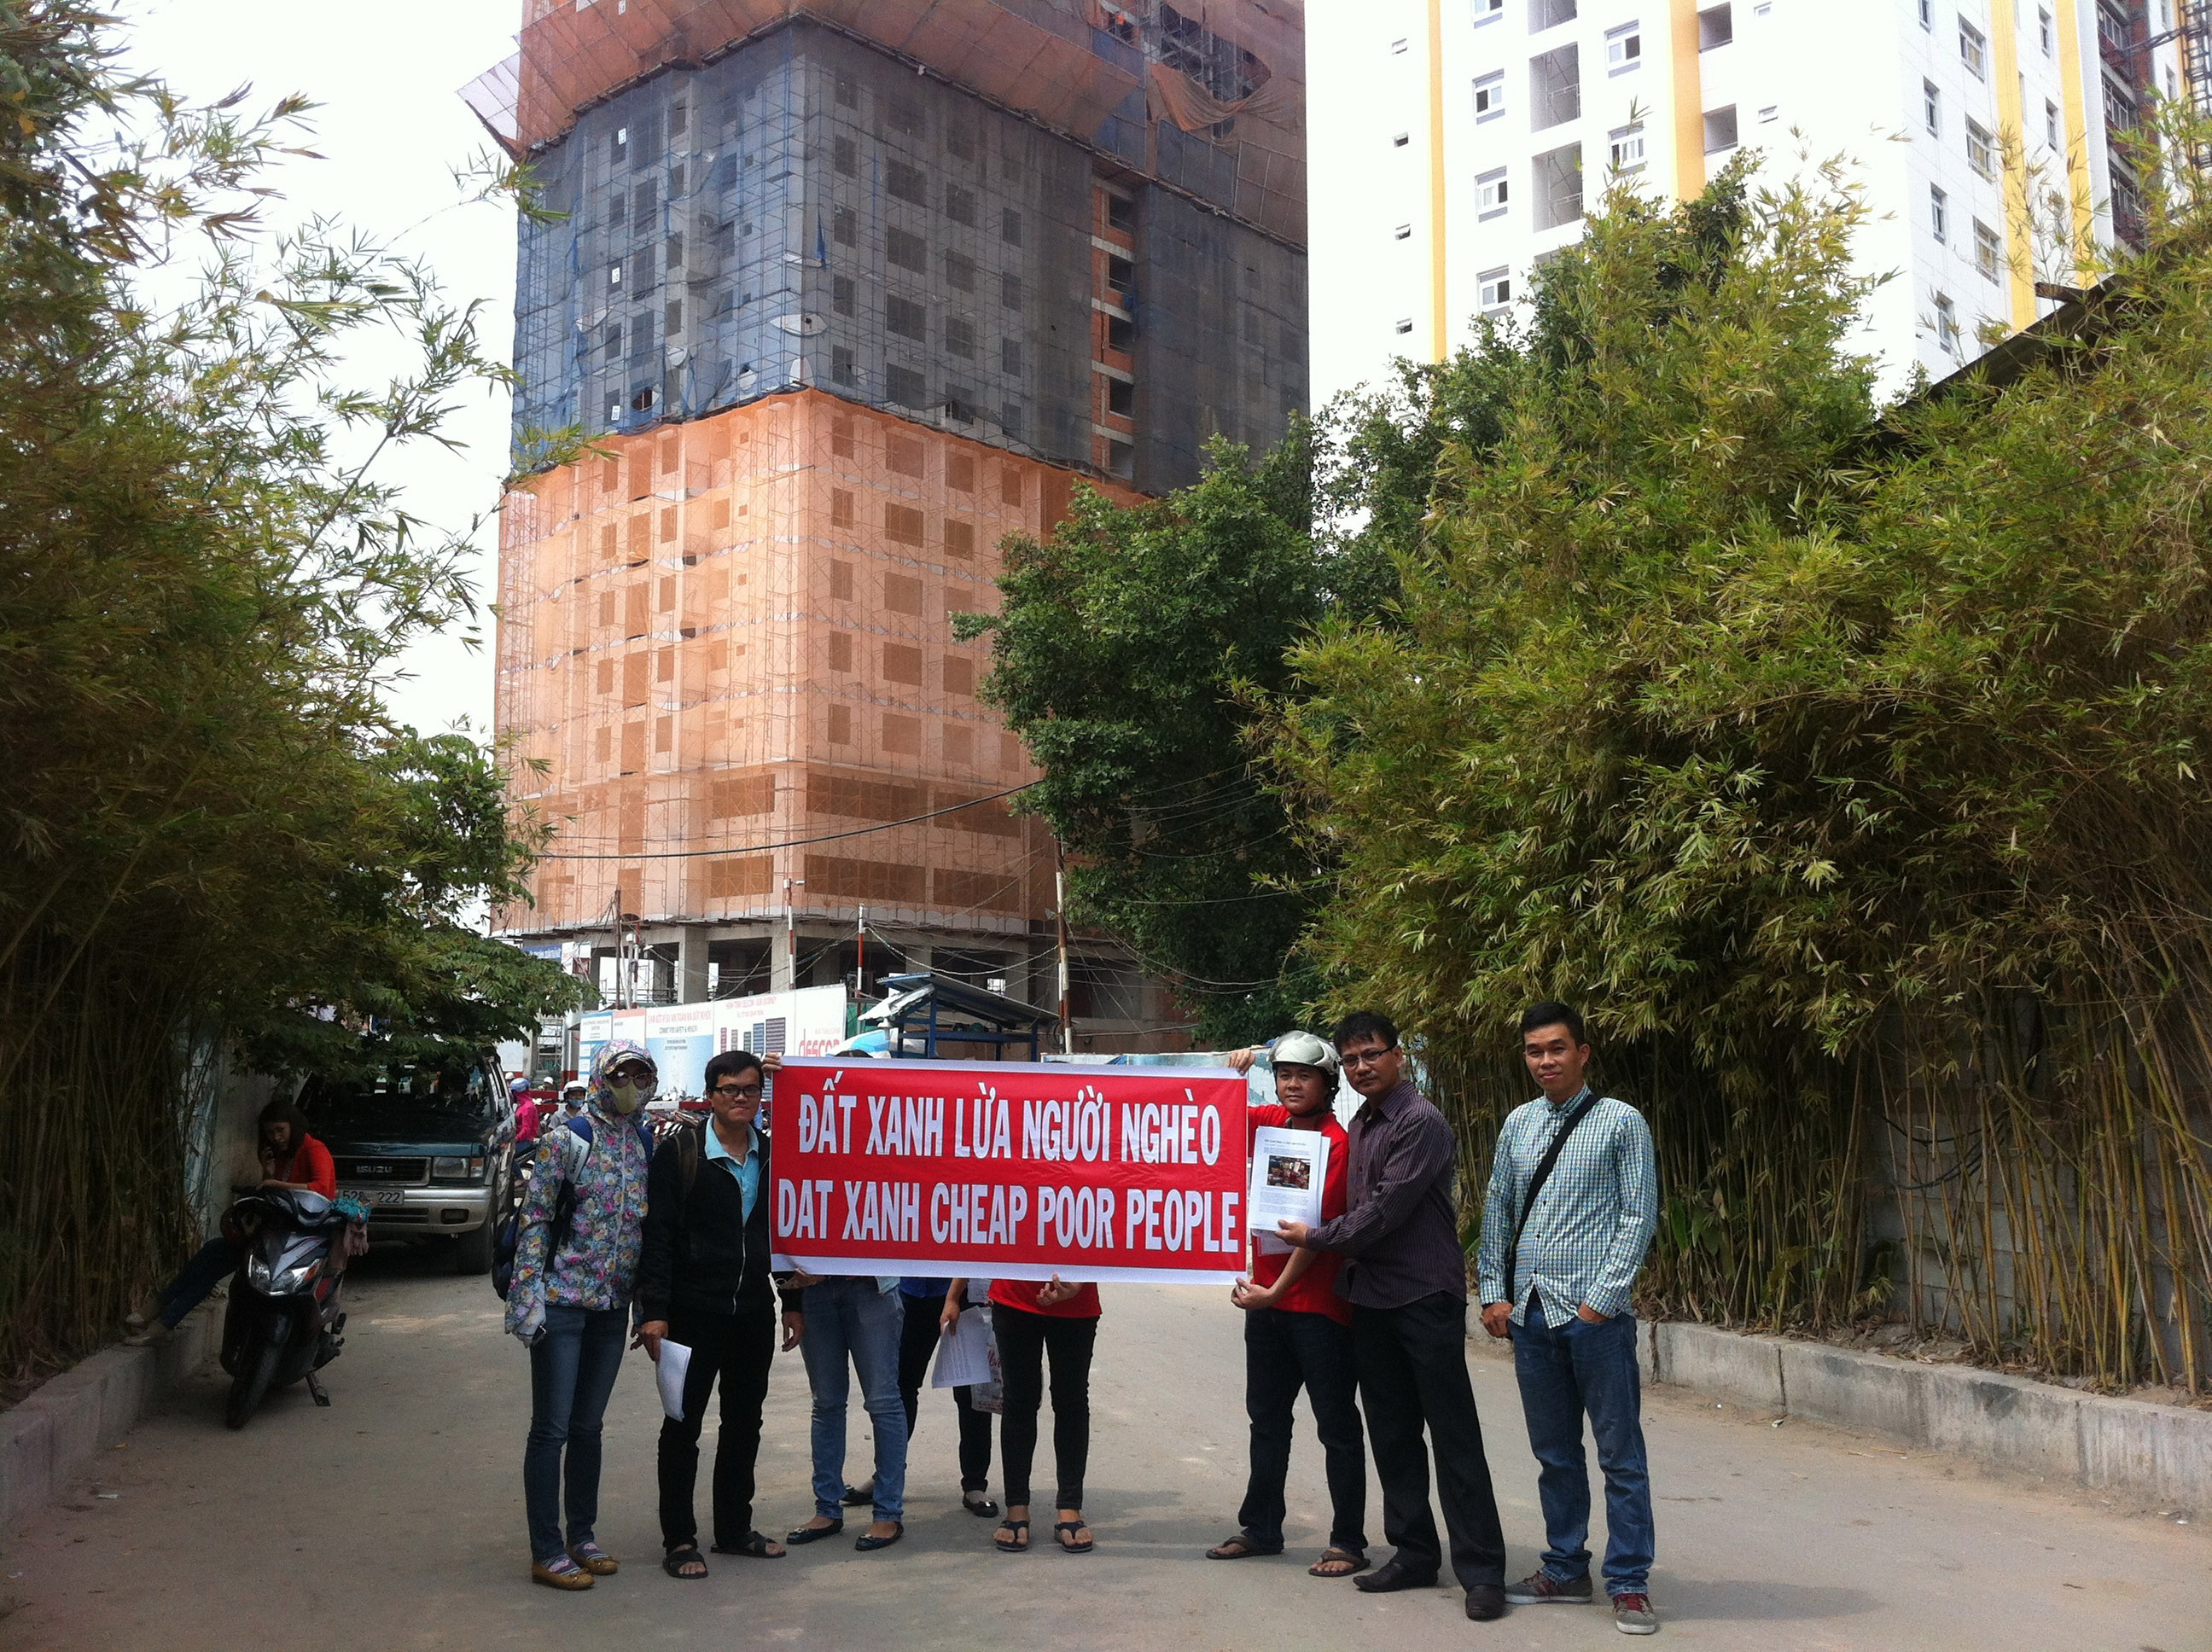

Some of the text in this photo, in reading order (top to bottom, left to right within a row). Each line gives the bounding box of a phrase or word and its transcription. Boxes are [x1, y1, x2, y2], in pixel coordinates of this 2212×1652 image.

[798, 1071, 1221, 1166] ĐẤT XANH LỪA NGƯỜI NGHÈO
[777, 1178, 1240, 1253] DAT XANH CHEAP POOR PEOPLE
